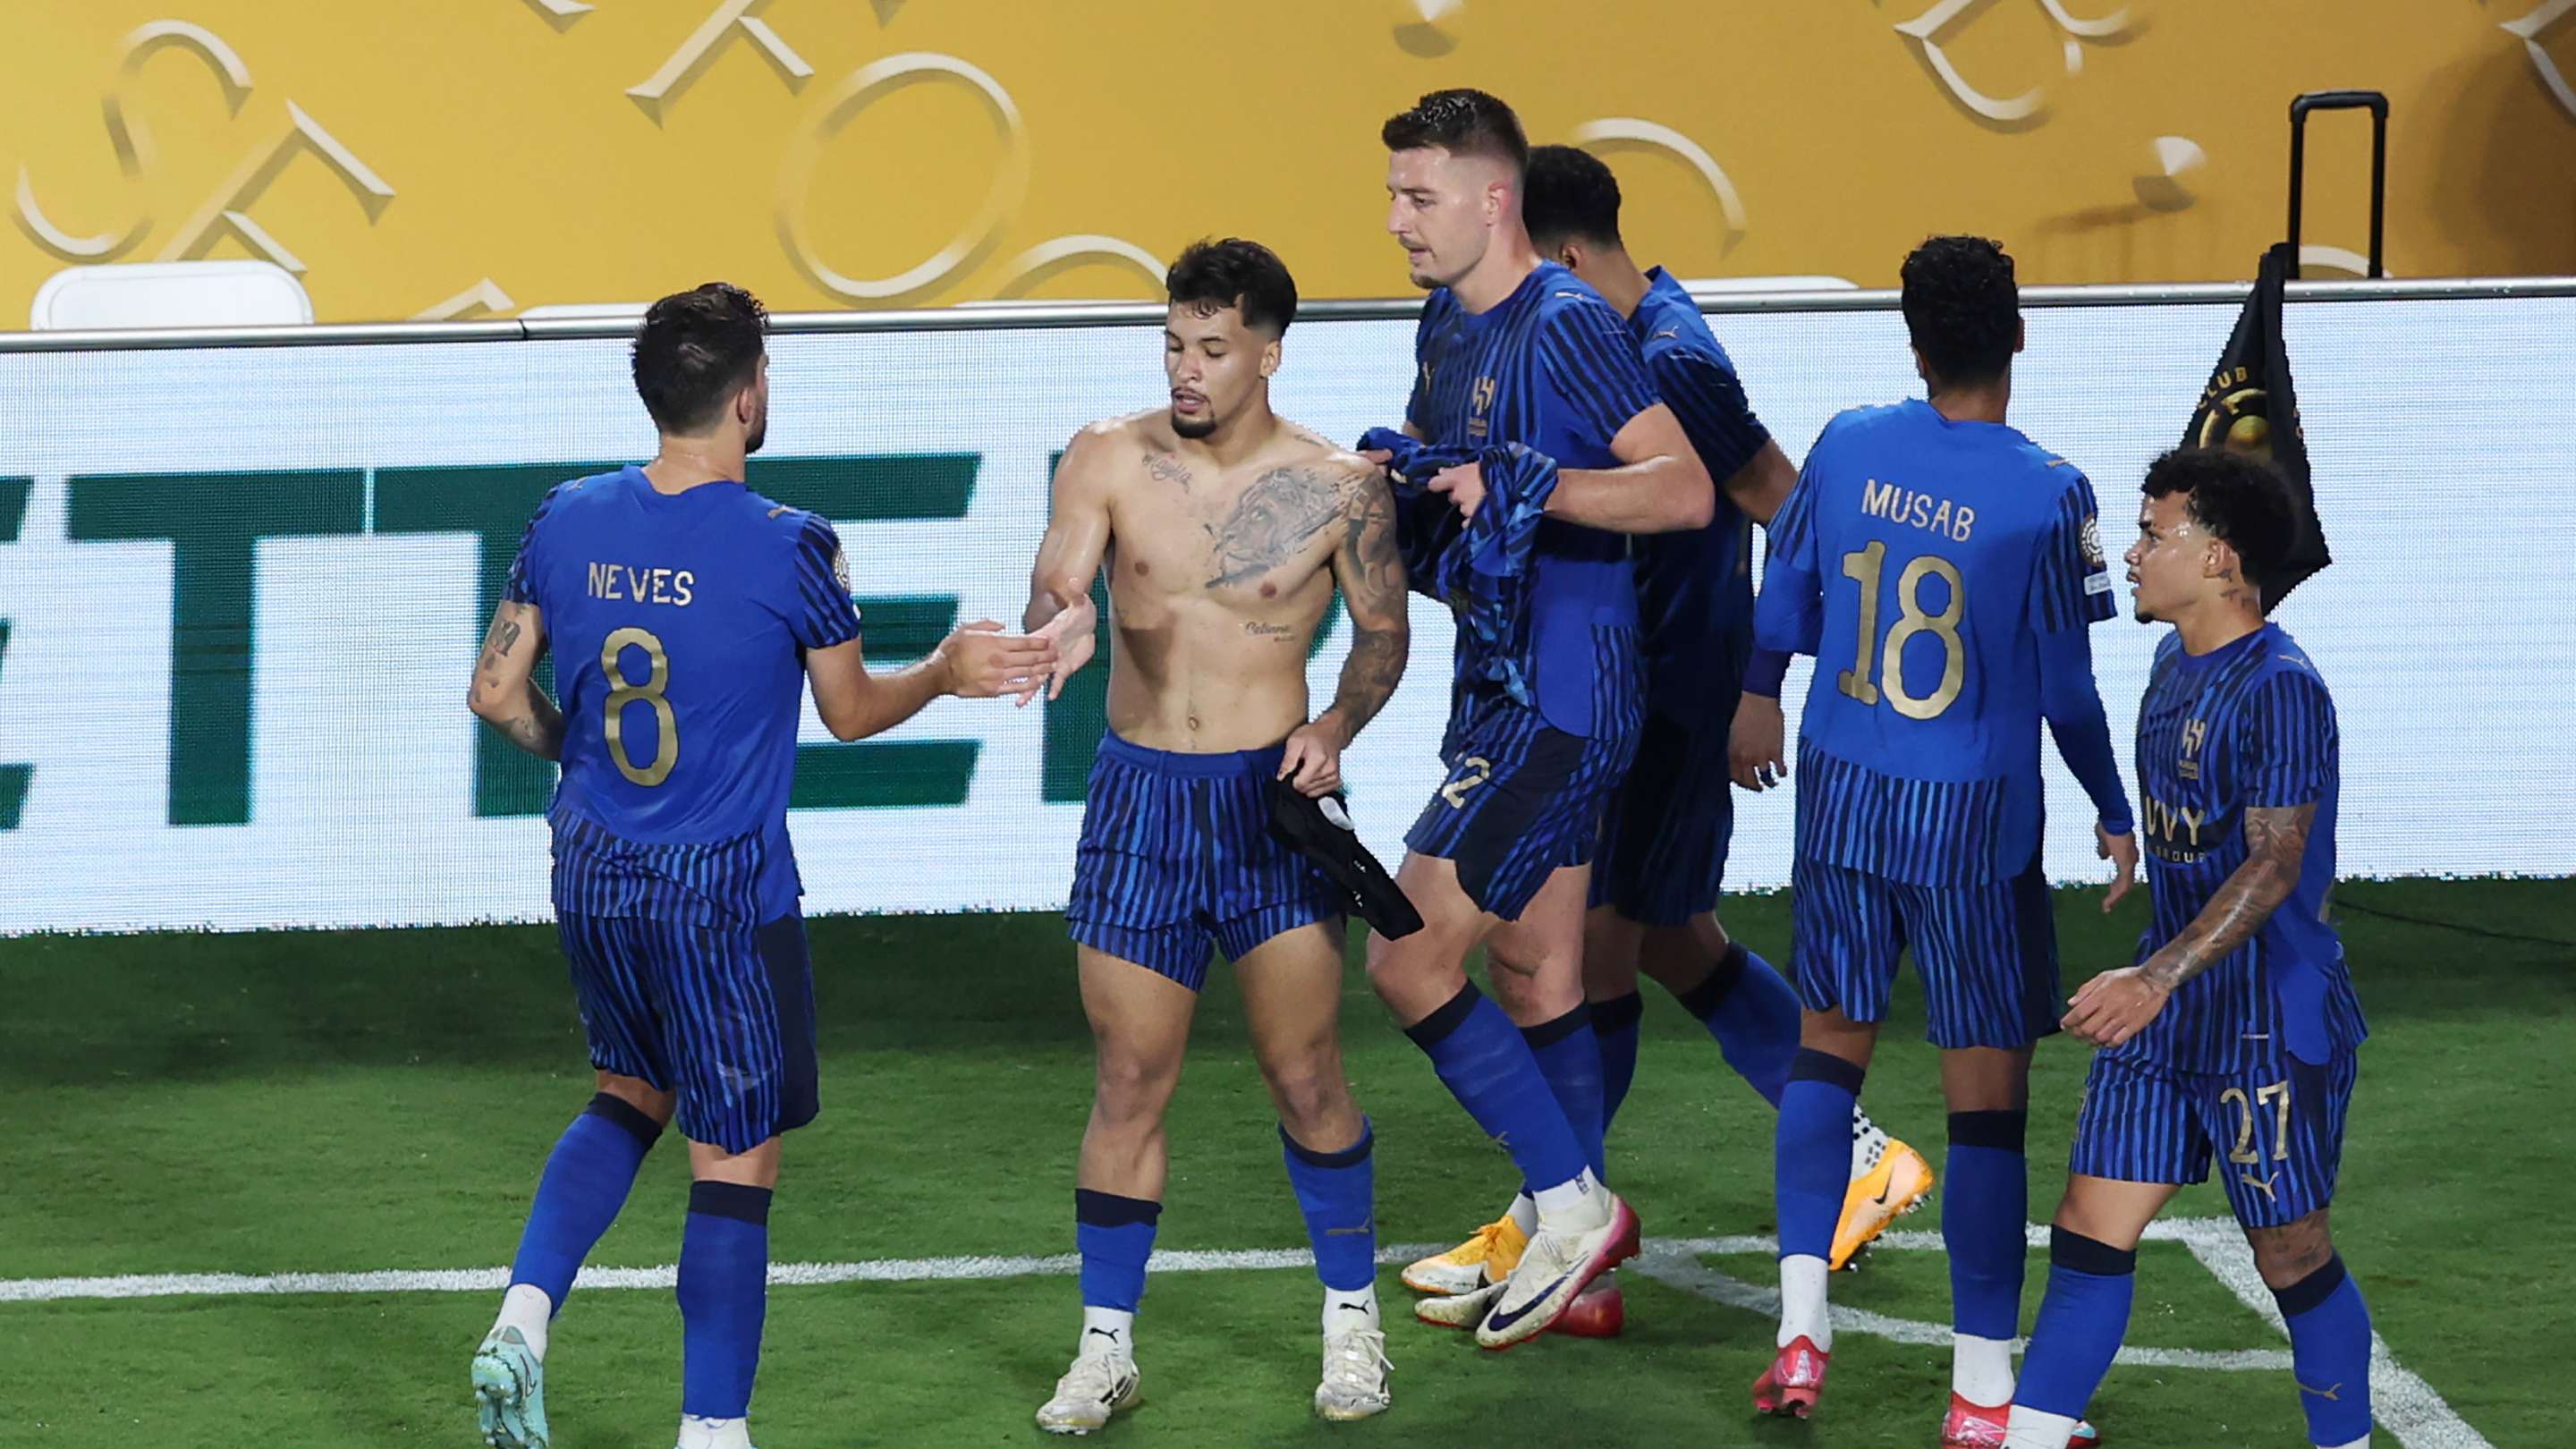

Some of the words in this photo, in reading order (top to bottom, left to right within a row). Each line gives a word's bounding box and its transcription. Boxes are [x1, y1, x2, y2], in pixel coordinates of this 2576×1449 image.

[1861, 479, 1975, 542] MUSAB
[588, 562, 695, 606] NEVES
[1837, 539, 1965, 720] 18
[601, 626, 679, 787] 8
[2220, 1080, 2289, 1165] 27
